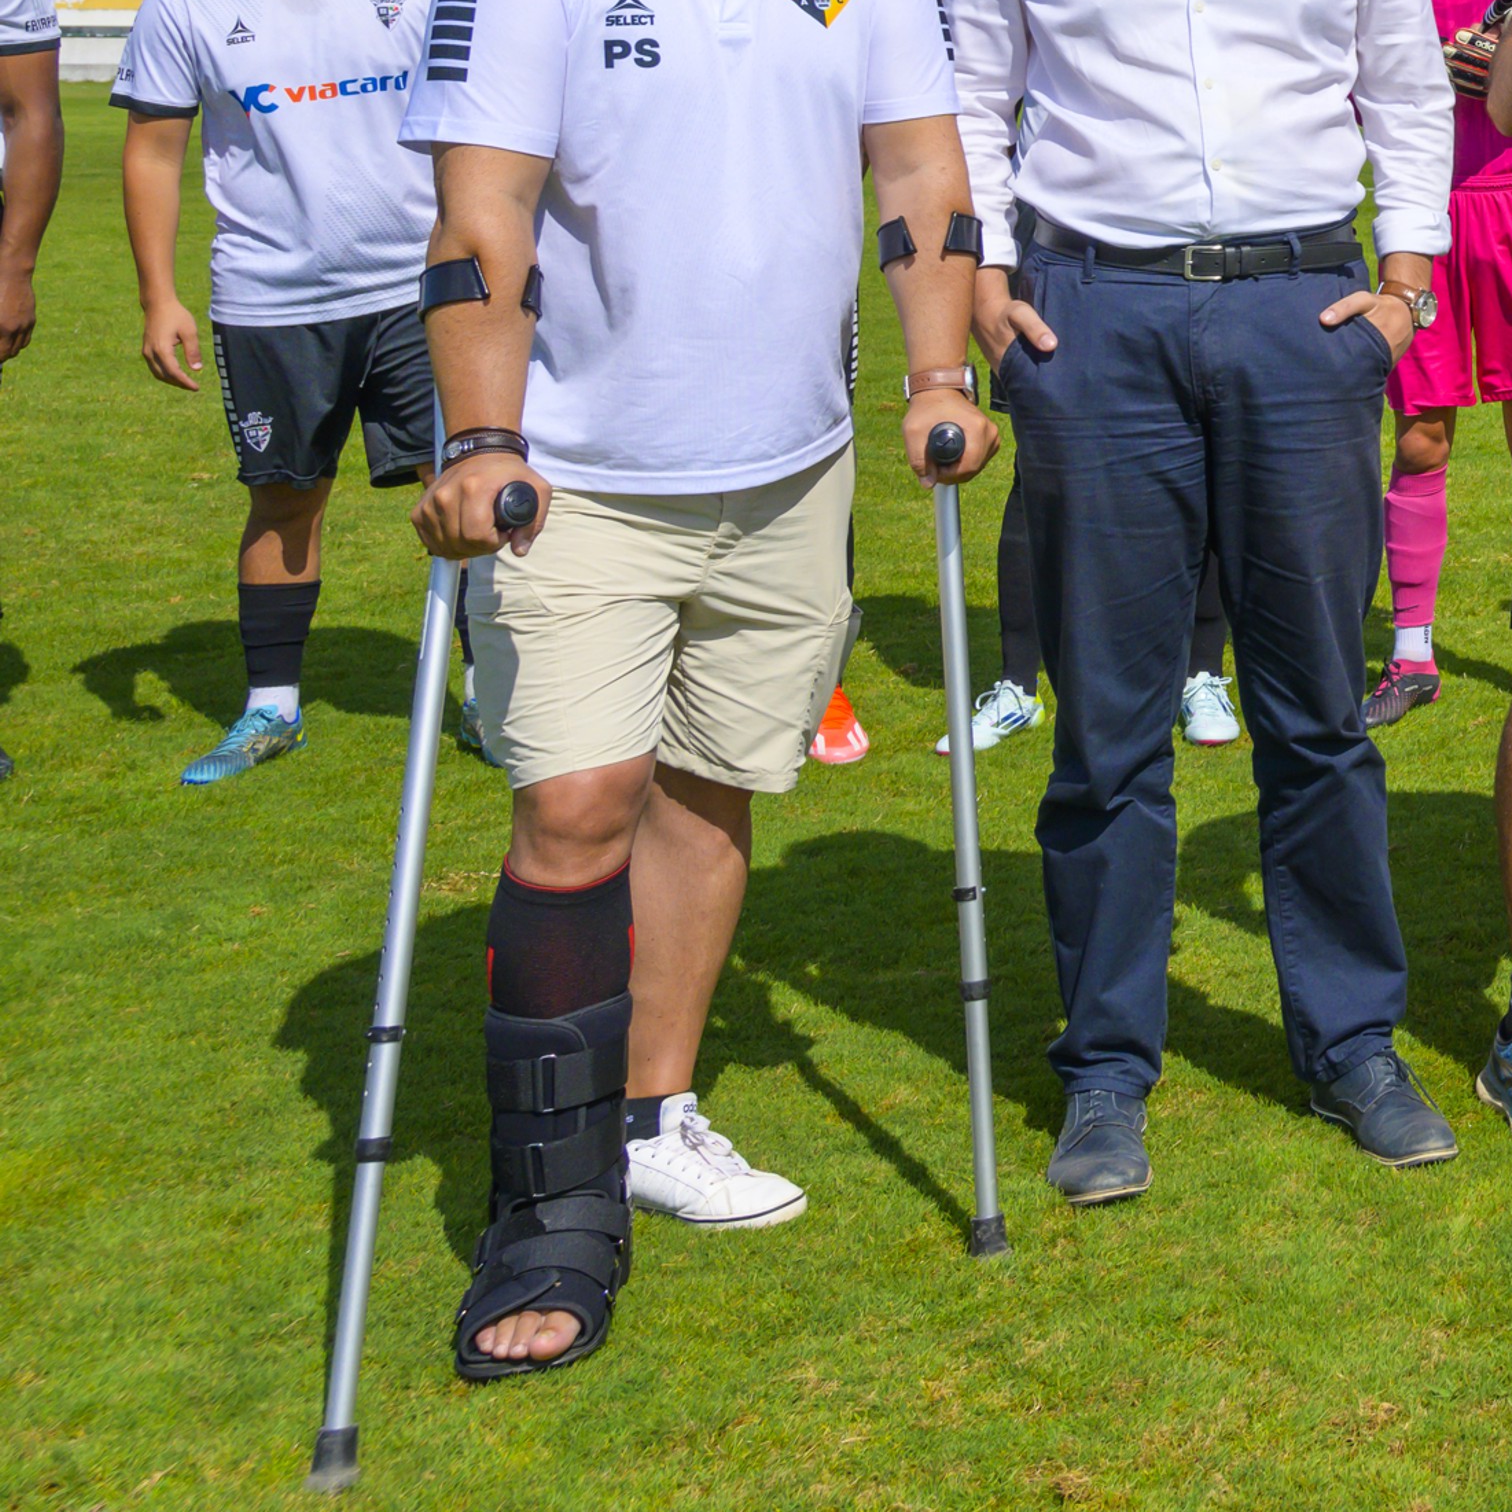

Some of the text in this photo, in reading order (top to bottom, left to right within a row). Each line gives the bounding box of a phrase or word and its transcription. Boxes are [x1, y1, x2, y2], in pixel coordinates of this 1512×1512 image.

[605, 14, 655, 26] SELECT
[226, 34, 256, 46] SELECT
[603, 38, 661, 68] PS
[284, 70, 409, 103] viacard
